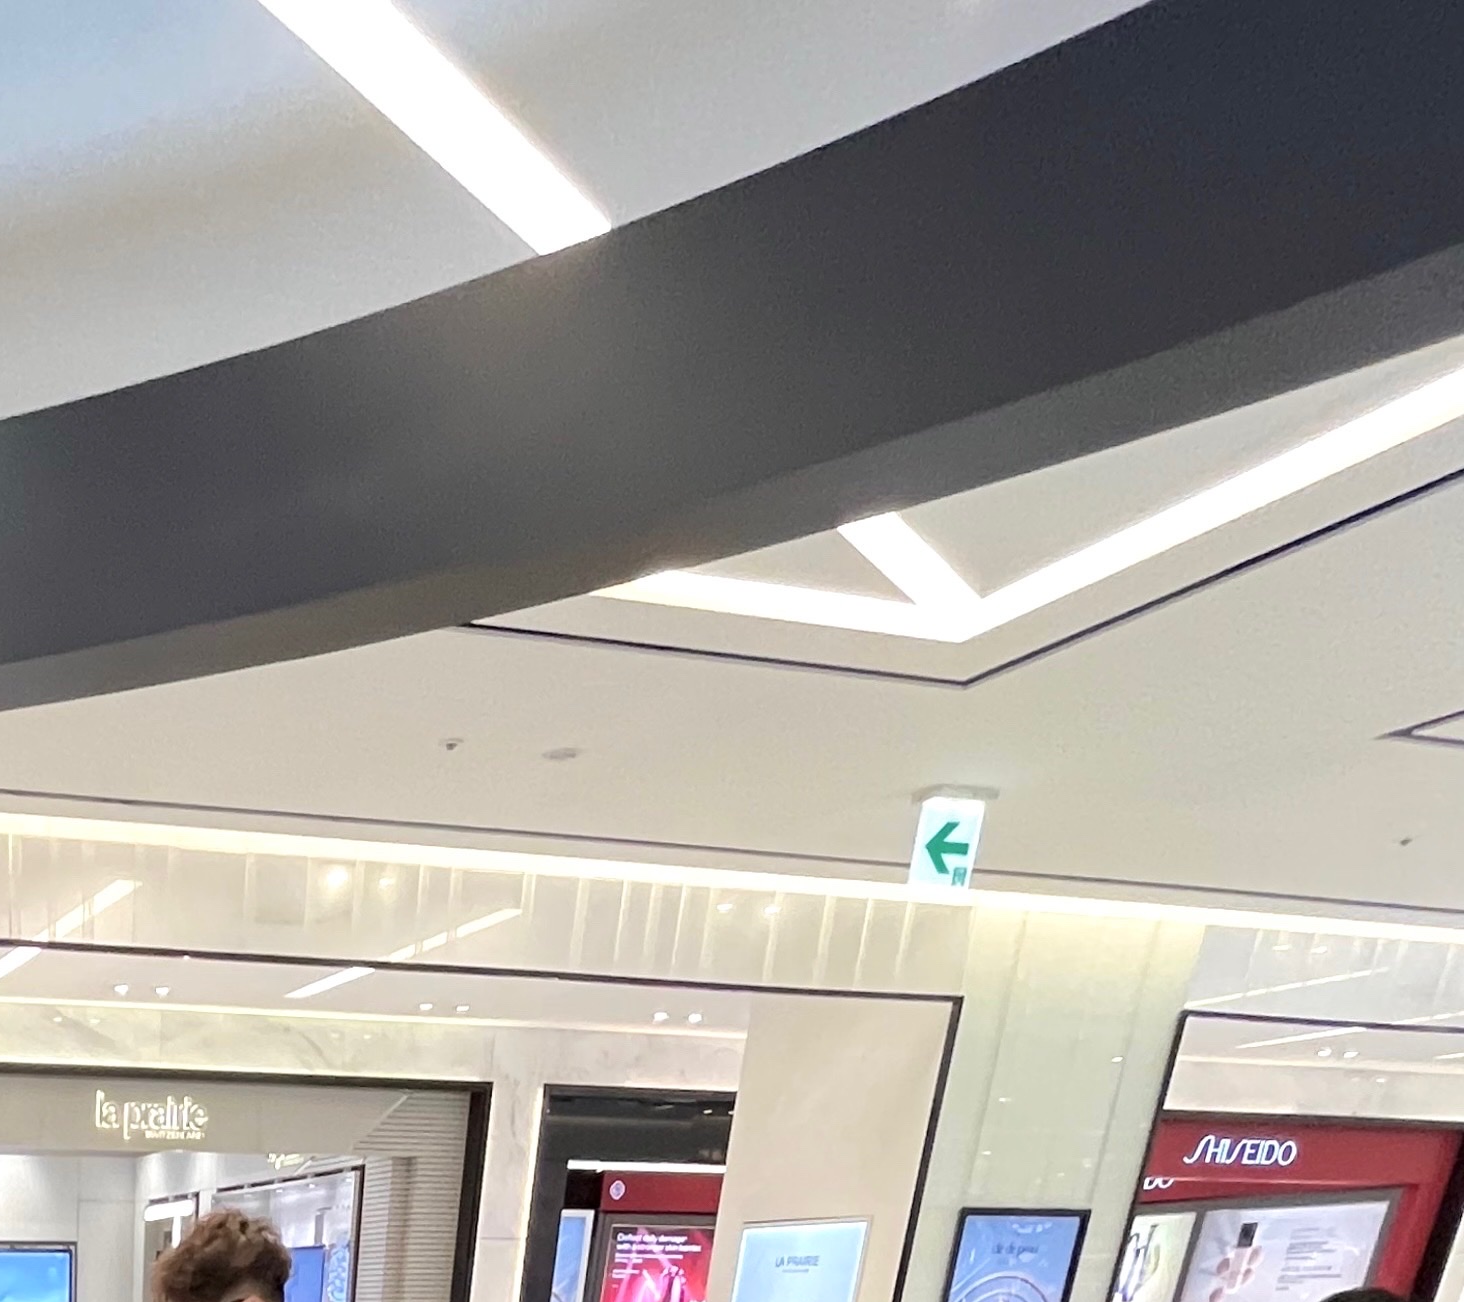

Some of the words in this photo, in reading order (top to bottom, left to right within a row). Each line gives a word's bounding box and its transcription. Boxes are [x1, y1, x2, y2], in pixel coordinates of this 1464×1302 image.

[95, 1089, 120, 1129] la
[123, 1095, 209, 1141] prairie
[1183, 1134, 1298, 1167] SHISEIDO
